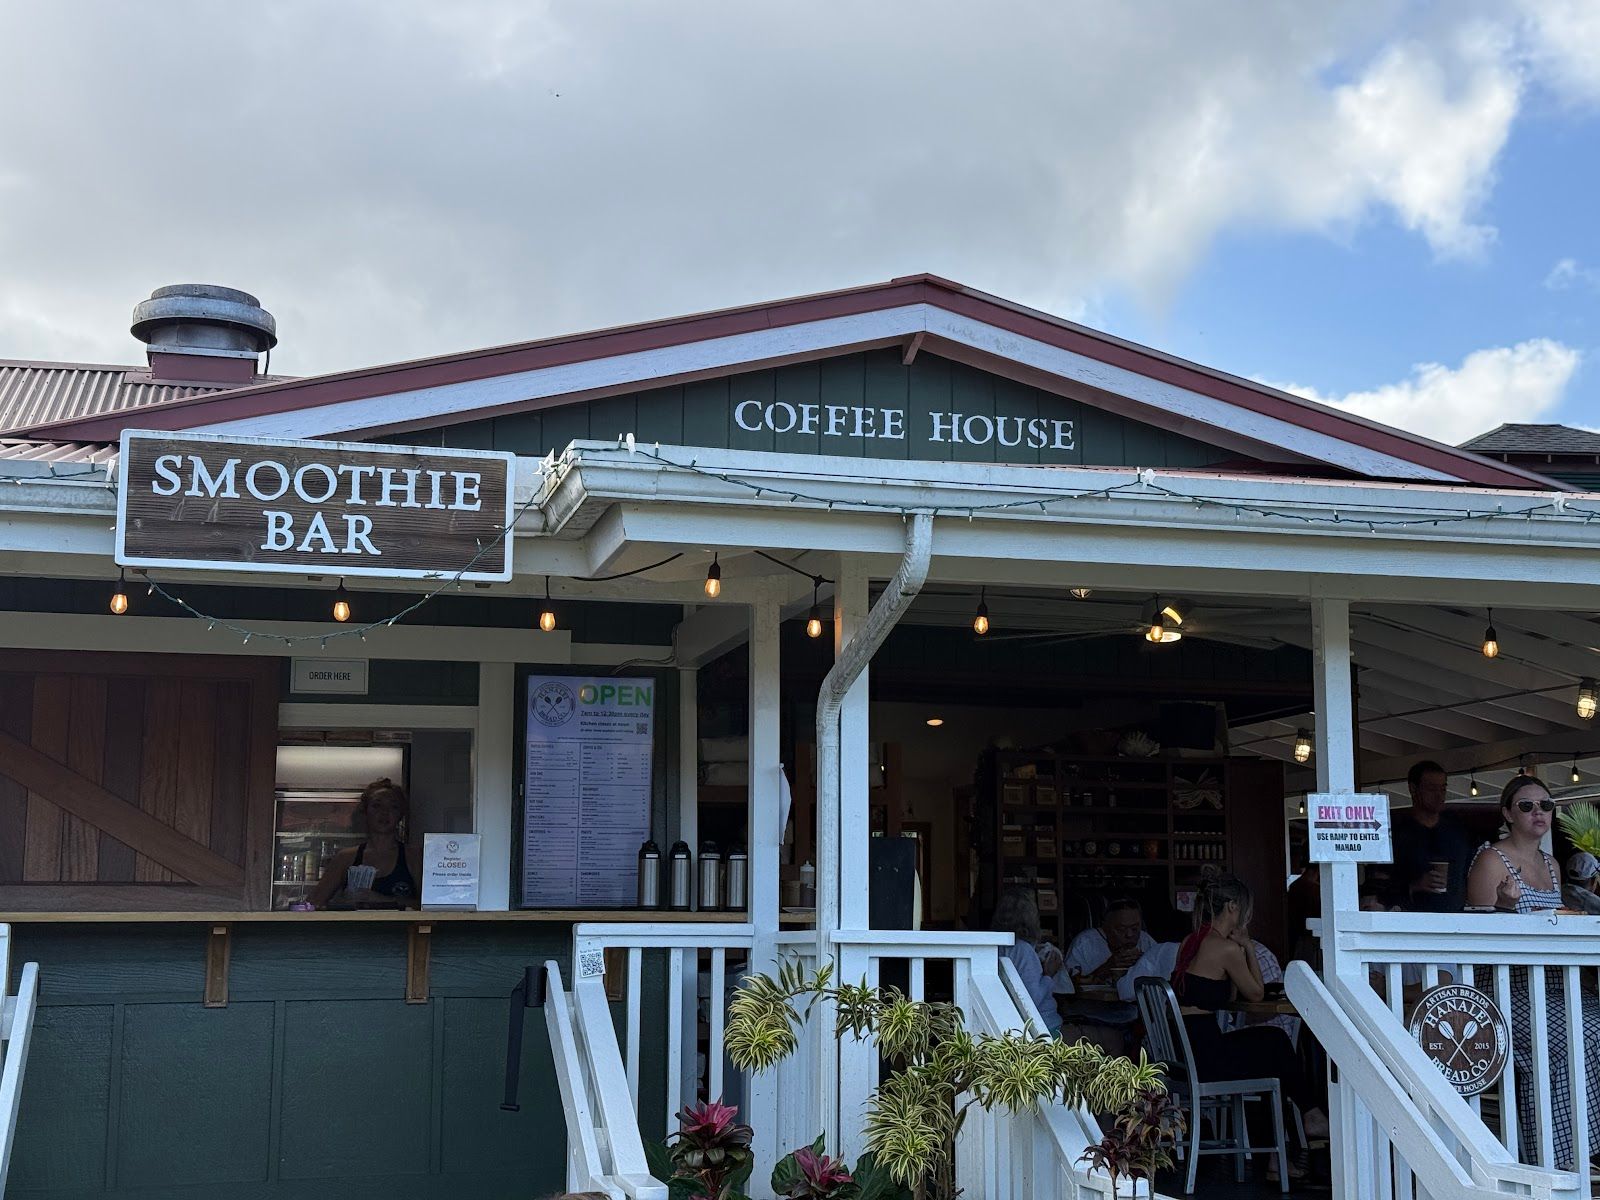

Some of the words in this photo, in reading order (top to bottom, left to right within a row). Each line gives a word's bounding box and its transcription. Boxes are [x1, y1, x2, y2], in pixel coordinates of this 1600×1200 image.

[734, 400, 905, 440] COFFEE
[928, 411, 1075, 450] HOUSE
[151, 454, 482, 512] SMOOTHIE
[260, 510, 382, 555] BAR
[309, 671, 332, 680] ORDER
[333, 672, 351, 681] HERE
[579, 685, 652, 706] OPEN
[1317, 805, 1342, 820] EXIT
[1345, 805, 1375, 820] ONLY
[1317, 832, 1329, 841] USE
[1329, 833, 1348, 841] RAMP
[1349, 833, 1358, 841] TO
[1359, 833, 1380, 841] ENTER
[1335, 843, 1362, 851] MAHALO
[1425, 988, 1458, 1009] ARTISAN
[1459, 988, 1489, 1009] BREADS
[1424, 999, 1491, 1029] HANALEI
[1429, 1042, 1444, 1050] EST.
[1431, 1056, 1470, 1081] BREAD
[1471, 1059, 1490, 1077] CO.
[1463, 1078, 1487, 1092] HOUSE
